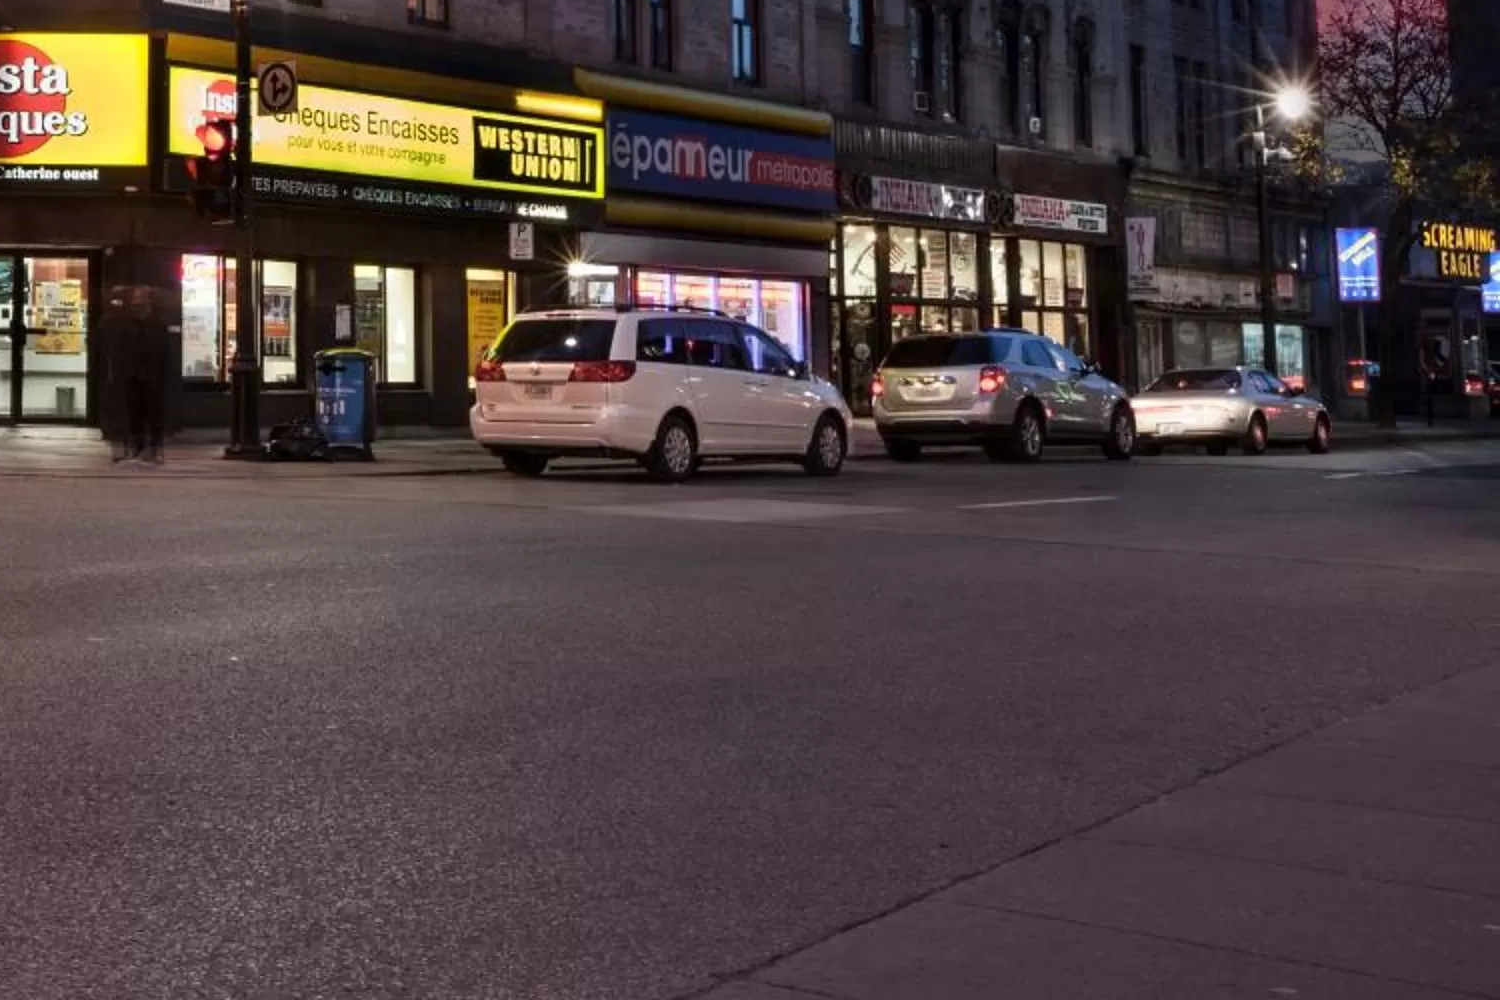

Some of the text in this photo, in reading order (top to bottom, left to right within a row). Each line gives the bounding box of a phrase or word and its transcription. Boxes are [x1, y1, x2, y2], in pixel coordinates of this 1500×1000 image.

[479, 125, 577, 159] WESTERN
[62, 167, 99, 181] ouest
[511, 153, 577, 183] UNION
[1422, 221, 1496, 253] SCREAMING
[1440, 249, 1482, 279] EAGLE
